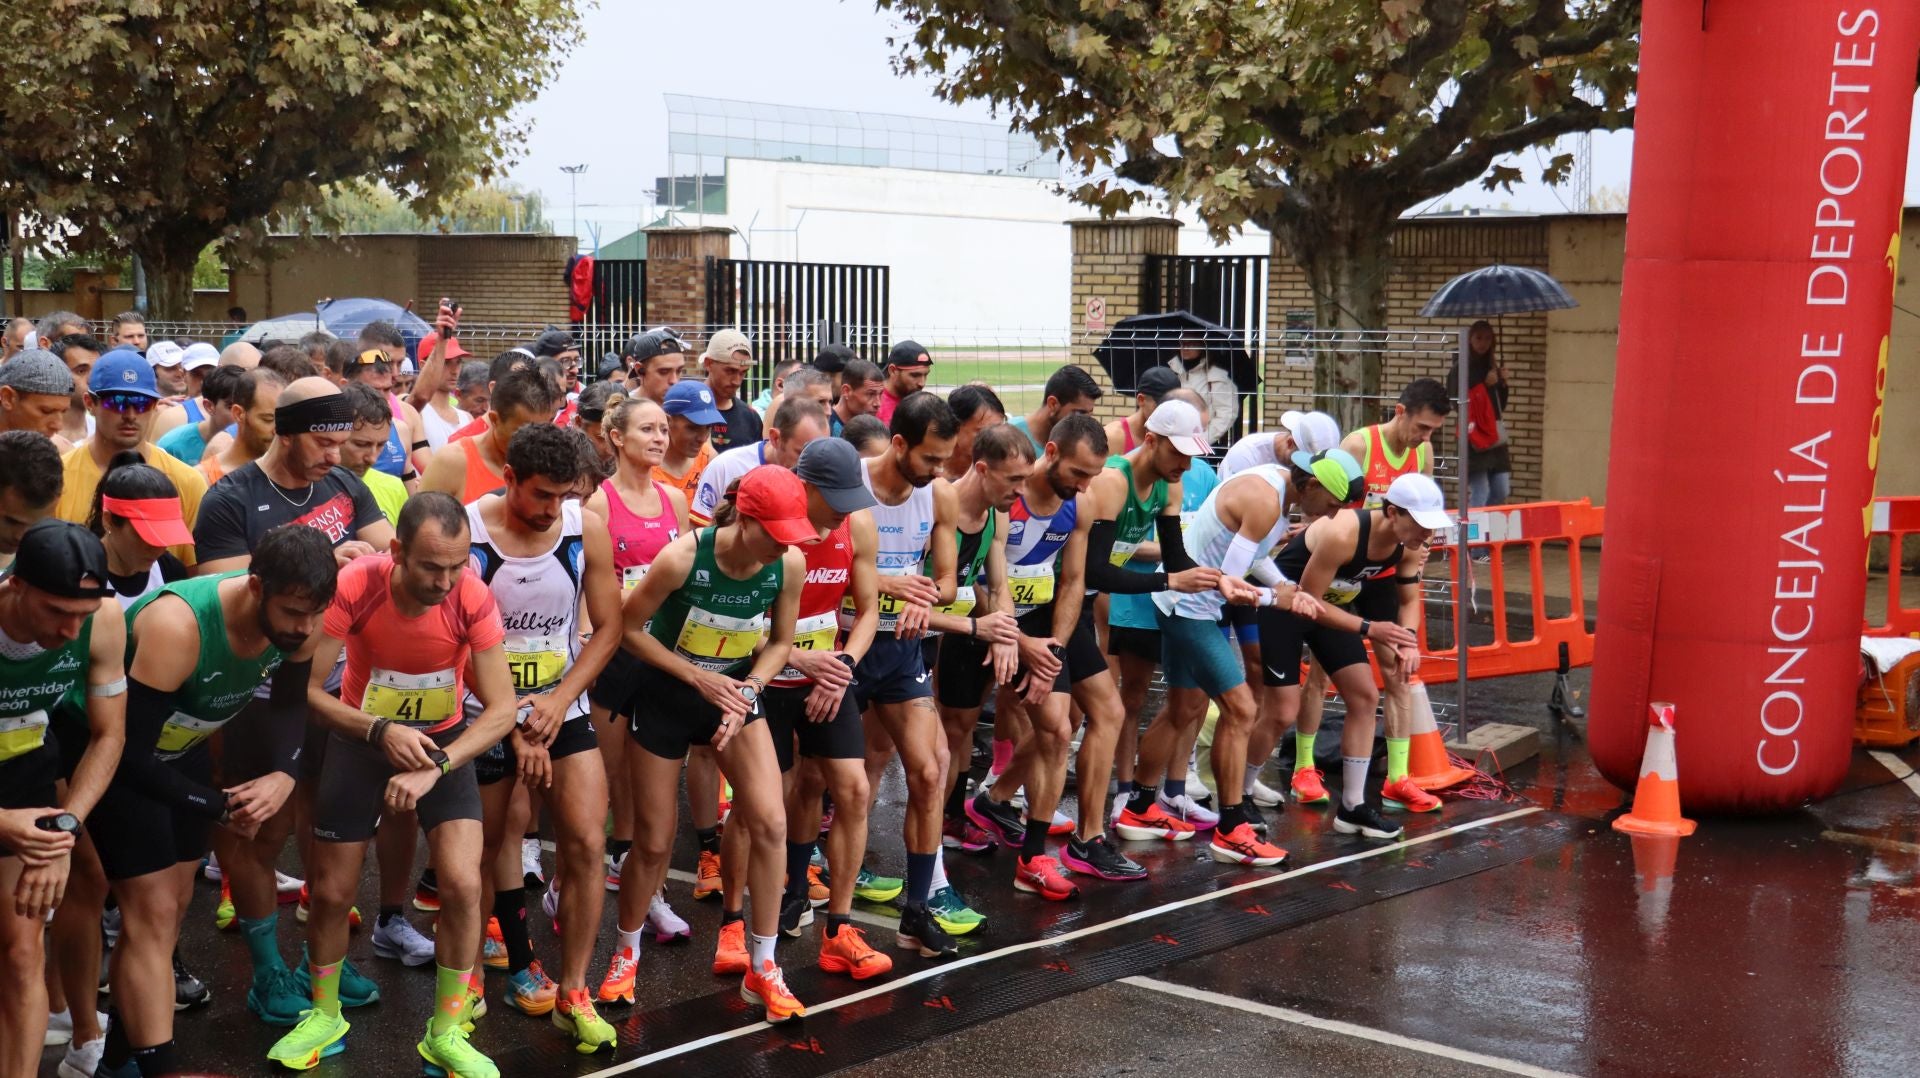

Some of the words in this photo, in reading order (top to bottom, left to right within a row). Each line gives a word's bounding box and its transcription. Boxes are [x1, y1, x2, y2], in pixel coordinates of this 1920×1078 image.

[1806, 9, 1880, 305] DEPORTES
[1795, 333, 1843, 404] DE
[711, 593, 751, 604] Facsa
[1012, 585, 1035, 603] 34
[1756, 430, 1832, 776] CONCEJALÍA
[715, 636, 727, 657] 1
[508, 662, 538, 687] 50
[0, 680, 75, 699] iversidad
[396, 697, 423, 720] 41
